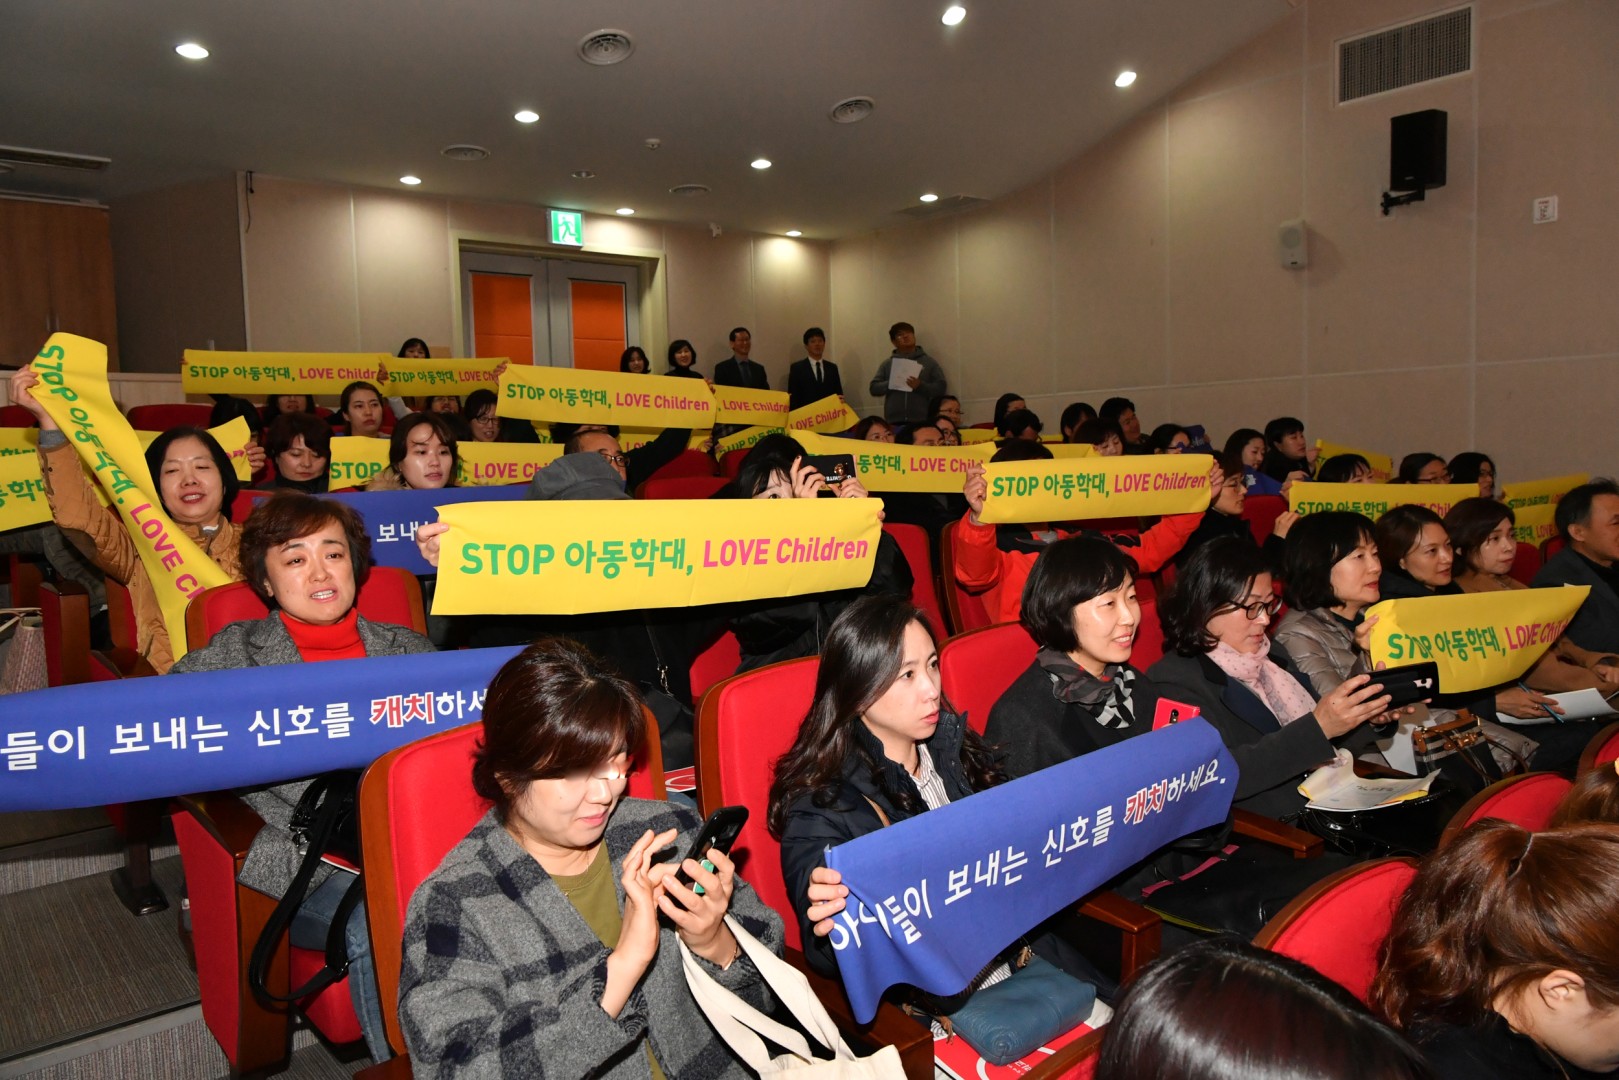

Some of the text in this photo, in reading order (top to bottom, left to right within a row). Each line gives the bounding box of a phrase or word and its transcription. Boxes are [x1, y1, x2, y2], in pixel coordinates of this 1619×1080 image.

[190, 365, 377, 383] STOP 아동학대, LOVE Childr
[389, 371, 416, 383] STOP
[459, 371, 482, 382] LOVE
[507, 383, 710, 411] STOP 아동학대, LOVE Children
[723, 400, 750, 411] LOVE
[753, 402, 789, 413] Childre
[35, 344, 79, 403] STOP
[130, 503, 185, 572] LOVE
[330, 461, 382, 479] STOP
[474, 462, 518, 478] LOVE
[910, 457, 946, 473] LOVE
[991, 472, 1206, 500] STOP 아동학대, LOVE Children
[459, 537, 868, 580] STOP 아동학대, LOVE Children
[1434, 626, 1506, 662] 아동학대,
[1505, 623, 1541, 650] LOVE
[109, 716, 229, 754] 보내는
[248, 703, 355, 747] 신호를
[944, 846, 1028, 906] 보내는
[1042, 805, 1114, 868] 신호를
[1123, 759, 1226, 825] 캐치하세요.
